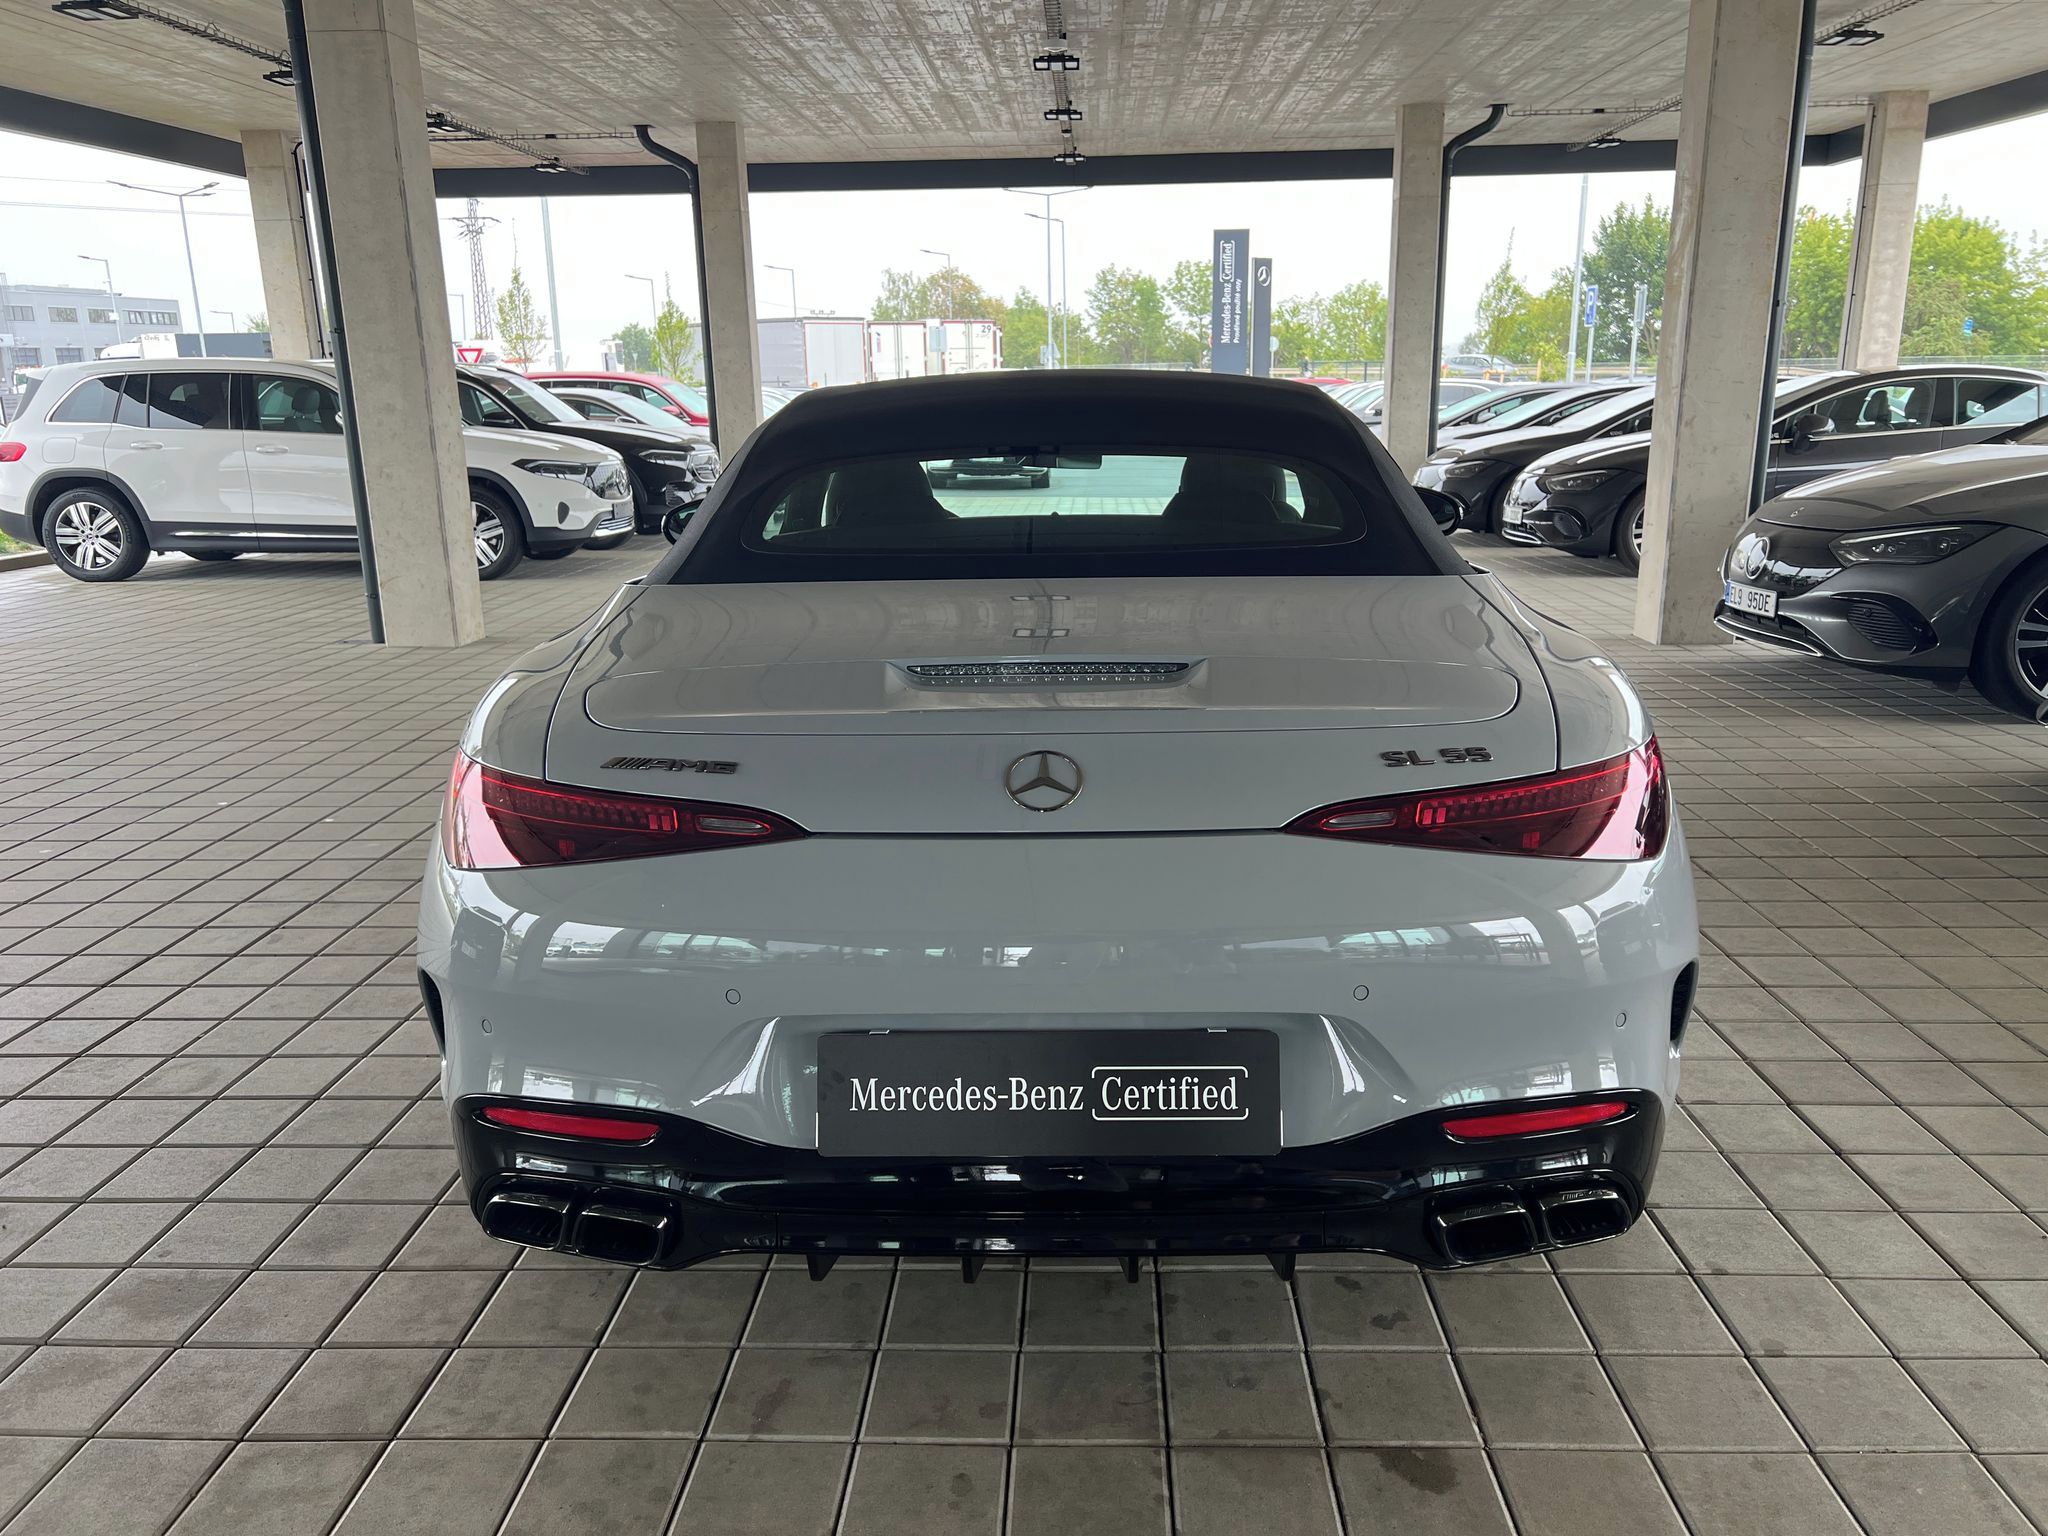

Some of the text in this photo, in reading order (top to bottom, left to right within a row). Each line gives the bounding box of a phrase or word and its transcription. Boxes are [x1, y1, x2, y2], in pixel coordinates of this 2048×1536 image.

[1220, 243, 1233, 344] Mercedes-Benz Certified
[1587, 291, 1594, 313] P
[981, 324, 992, 334] 29
[1730, 586, 1770, 612] EL9 95DE
[1379, 747, 1494, 767] SL 55
[849, 1076, 1239, 1112] Mercedes-Benz Certified
